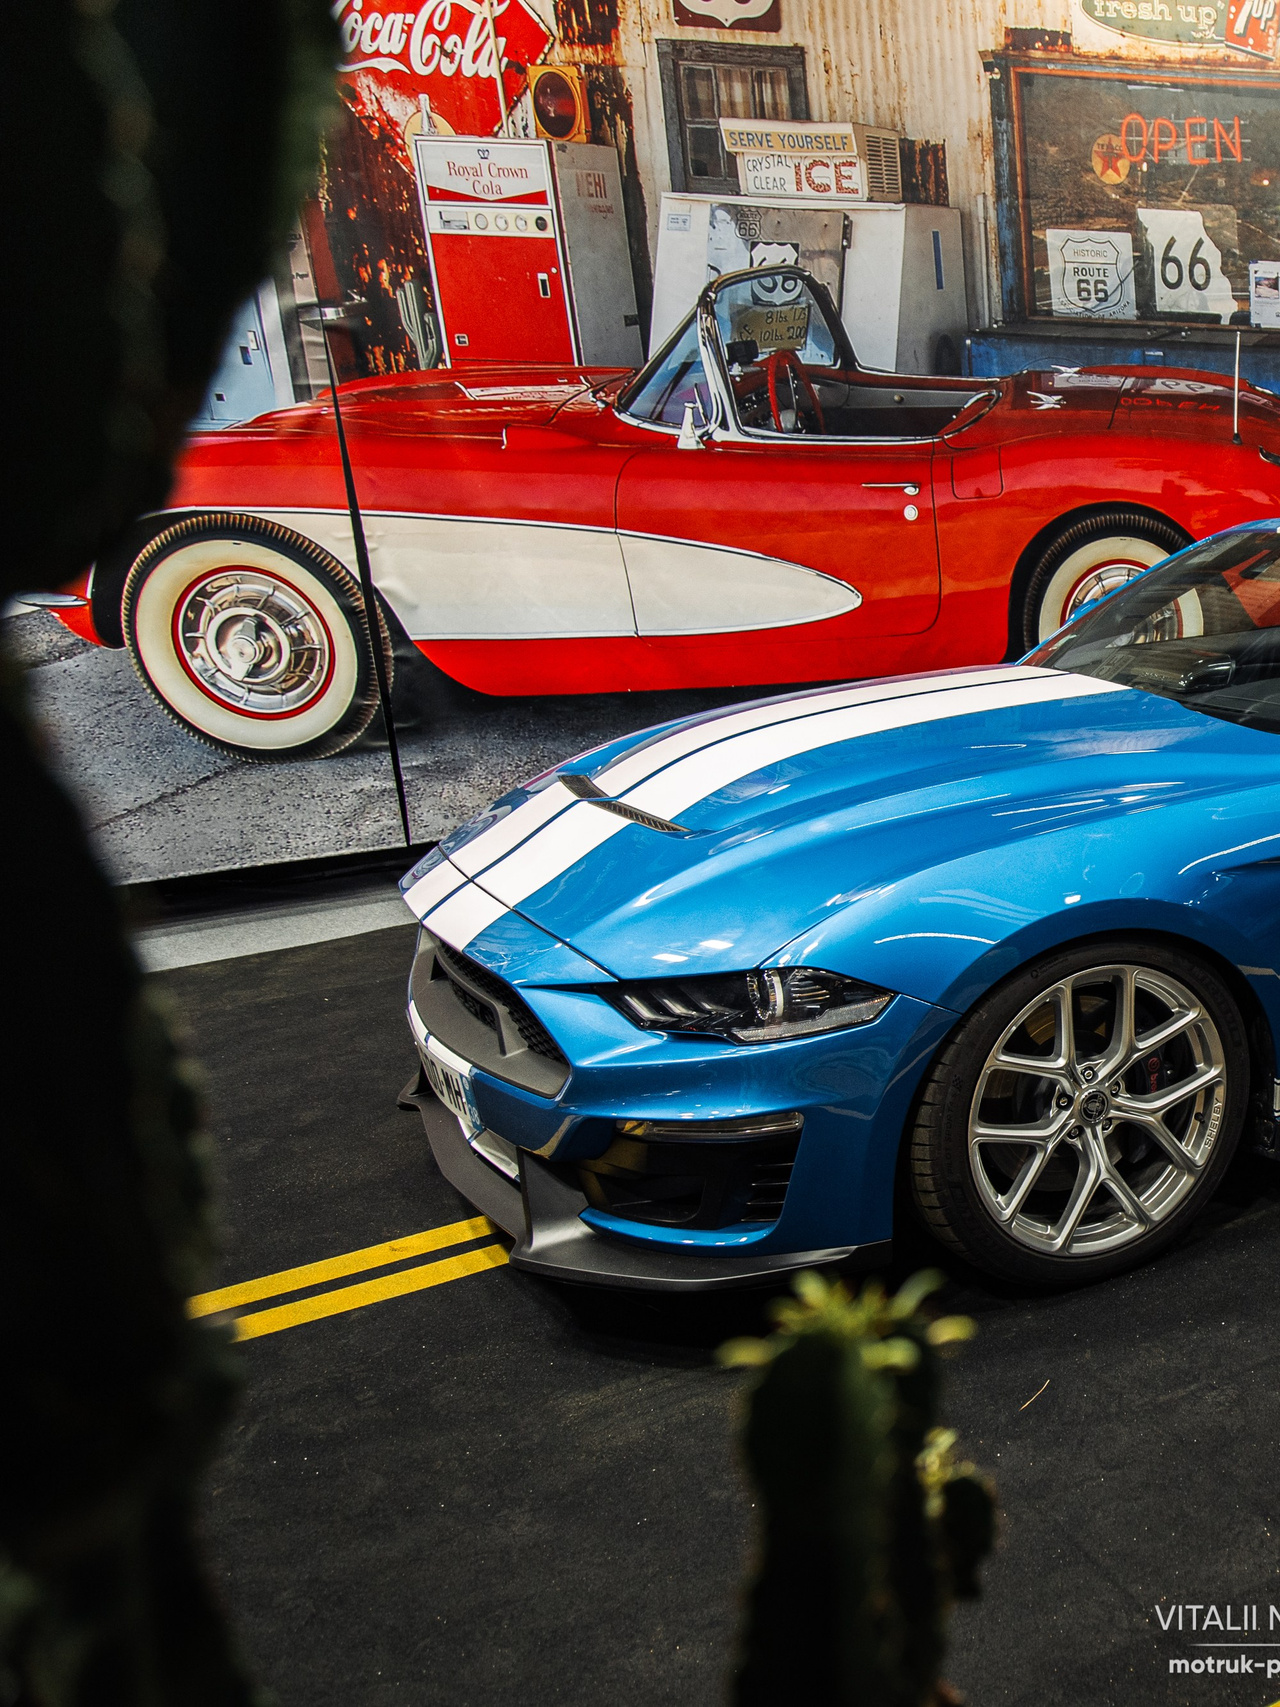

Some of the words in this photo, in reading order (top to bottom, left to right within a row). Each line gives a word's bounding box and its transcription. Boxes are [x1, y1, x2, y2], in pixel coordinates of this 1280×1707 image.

[334, 0, 507, 78] oca-Cola
[729, 131, 774, 148] SERVE
[777, 134, 849, 151] YOURSELF
[1120, 112, 1243, 165] OPEN
[447, 161, 484, 181] Royal
[487, 162, 530, 179] Crown
[746, 153, 793, 173] CRYSTAL
[753, 175, 788, 192] CLEAR
[793, 159, 860, 195] ICE
[471, 179, 503, 196] Cola
[738, 221, 758, 237] 66
[1073, 248, 1108, 258] HISTORIC
[1073, 267, 1110, 278] ROUTE
[1160, 235, 1212, 292] 66
[1076, 278, 1110, 303] 66
[1204, 1097, 1223, 1150] SHELBY
